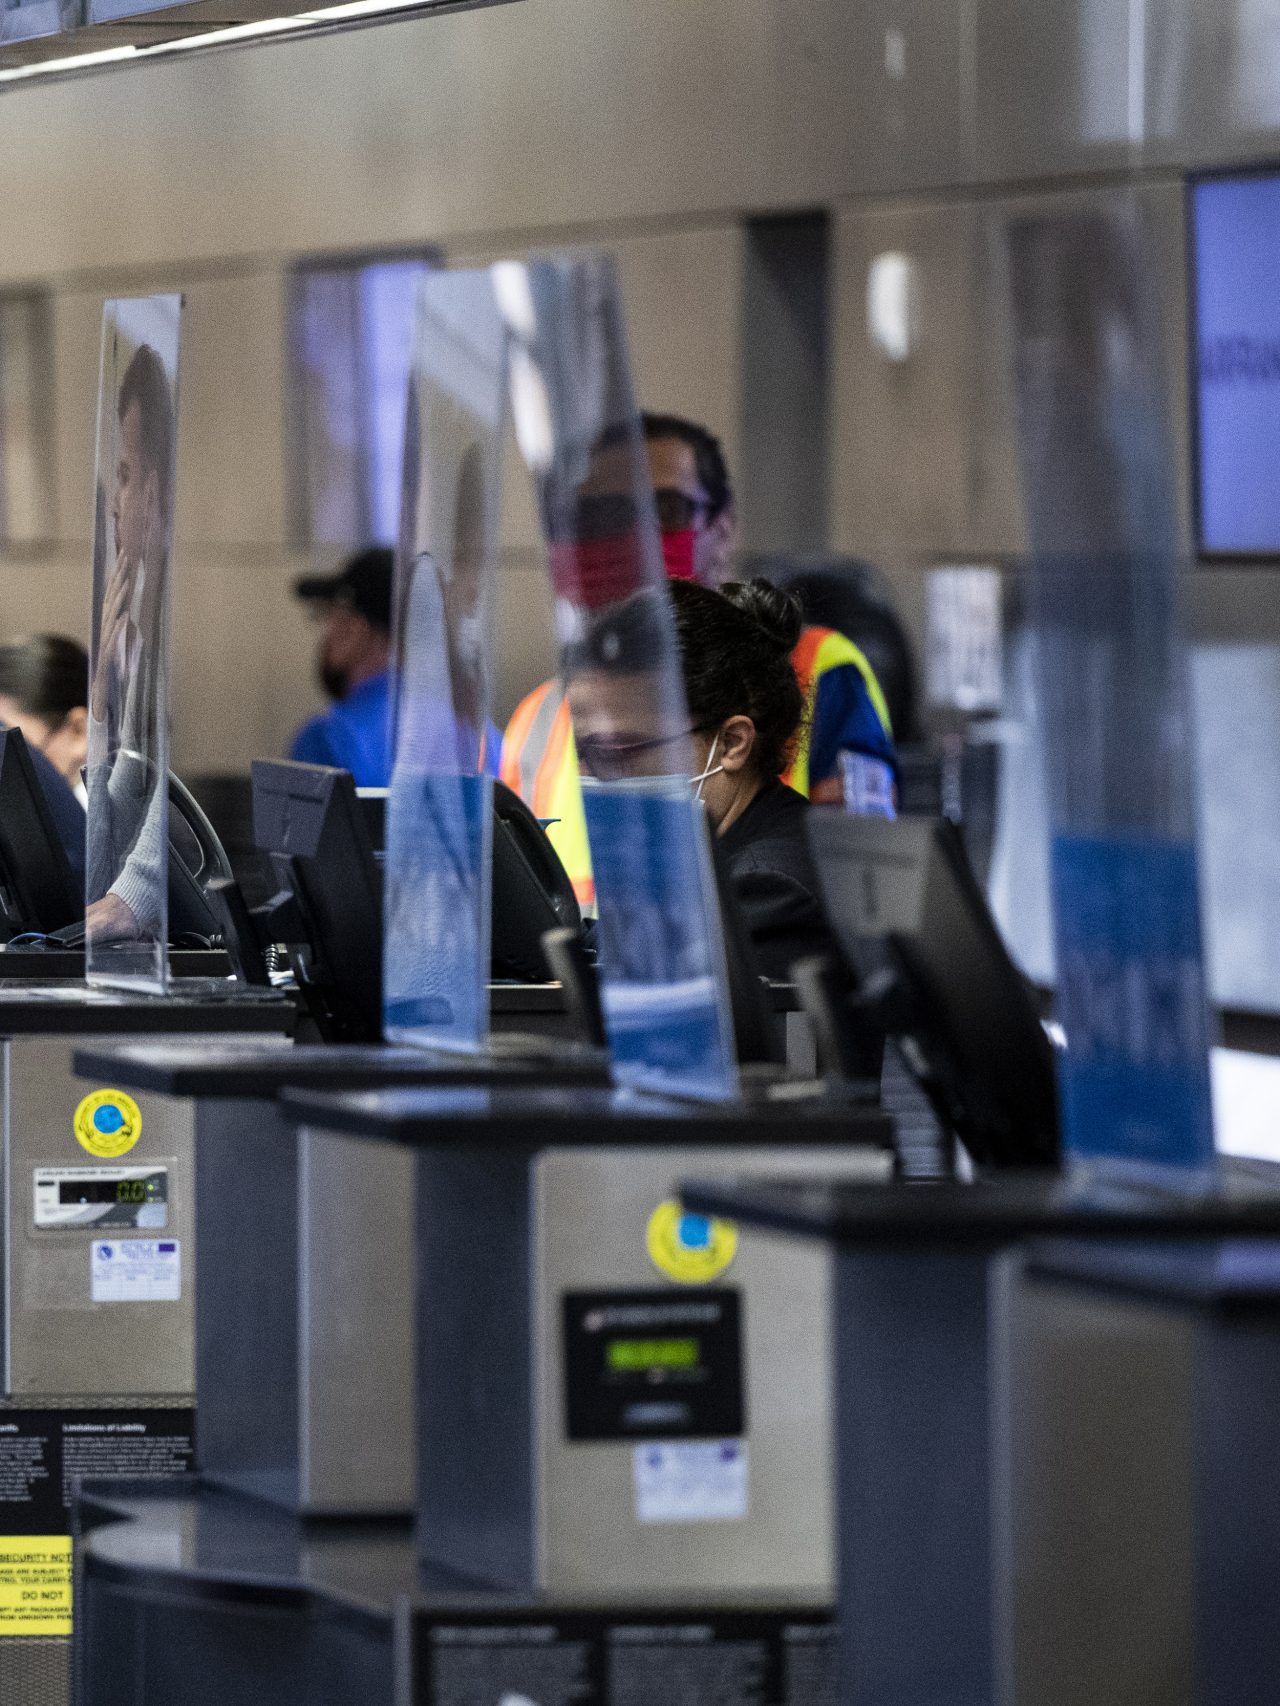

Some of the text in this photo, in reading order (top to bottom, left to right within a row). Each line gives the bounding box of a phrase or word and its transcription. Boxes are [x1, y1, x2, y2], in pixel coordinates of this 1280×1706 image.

[0, 1553, 48, 1563] SECURITY
[21, 1591, 63, 1600] DO NOT
